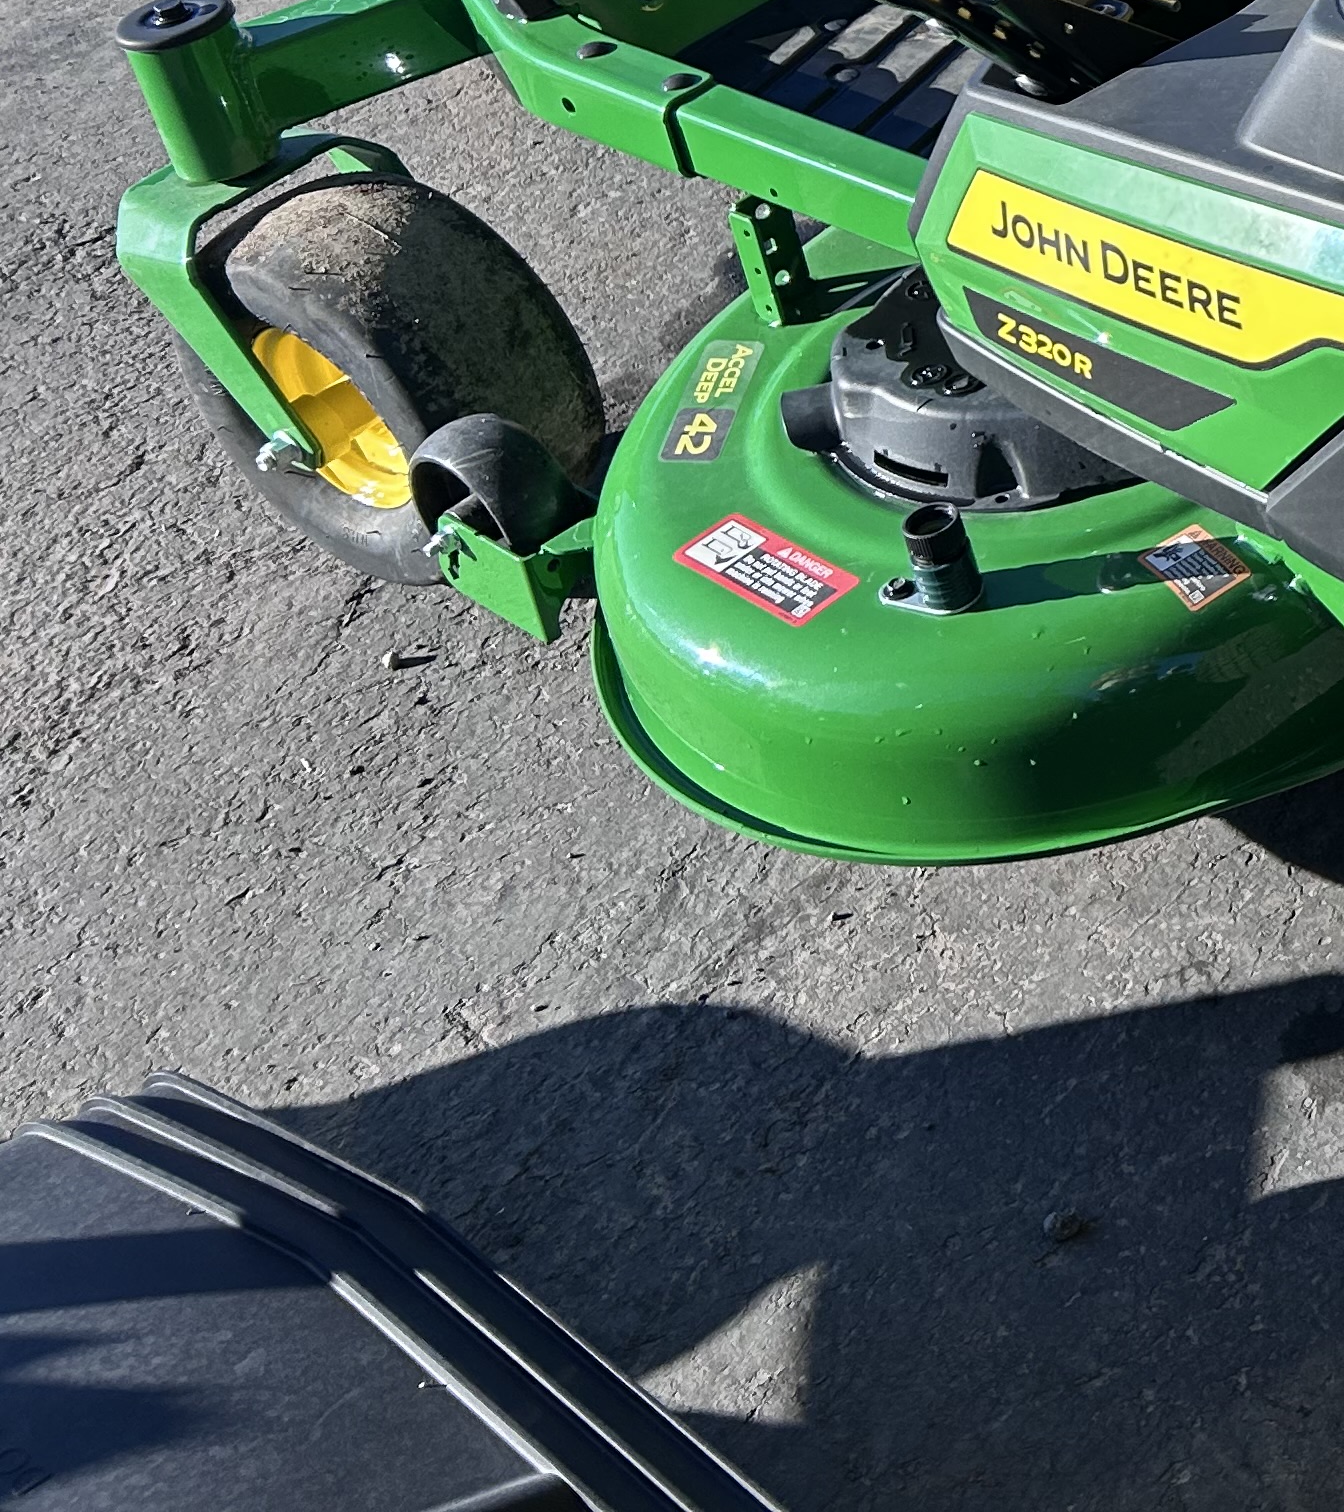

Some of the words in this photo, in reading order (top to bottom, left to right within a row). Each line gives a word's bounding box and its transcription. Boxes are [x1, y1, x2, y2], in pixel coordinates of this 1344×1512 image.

[991, 200, 1091, 273] JOHN
[1100, 239, 1243, 330] DEERE
[996, 312, 1093, 380] Z320R
[693, 357, 729, 404] DEEP
[713, 343, 754, 398] ACCEL
[674, 412, 718, 455] 42
[760, 552, 798, 578] ROTATING
[791, 551, 834, 579] DANGER
